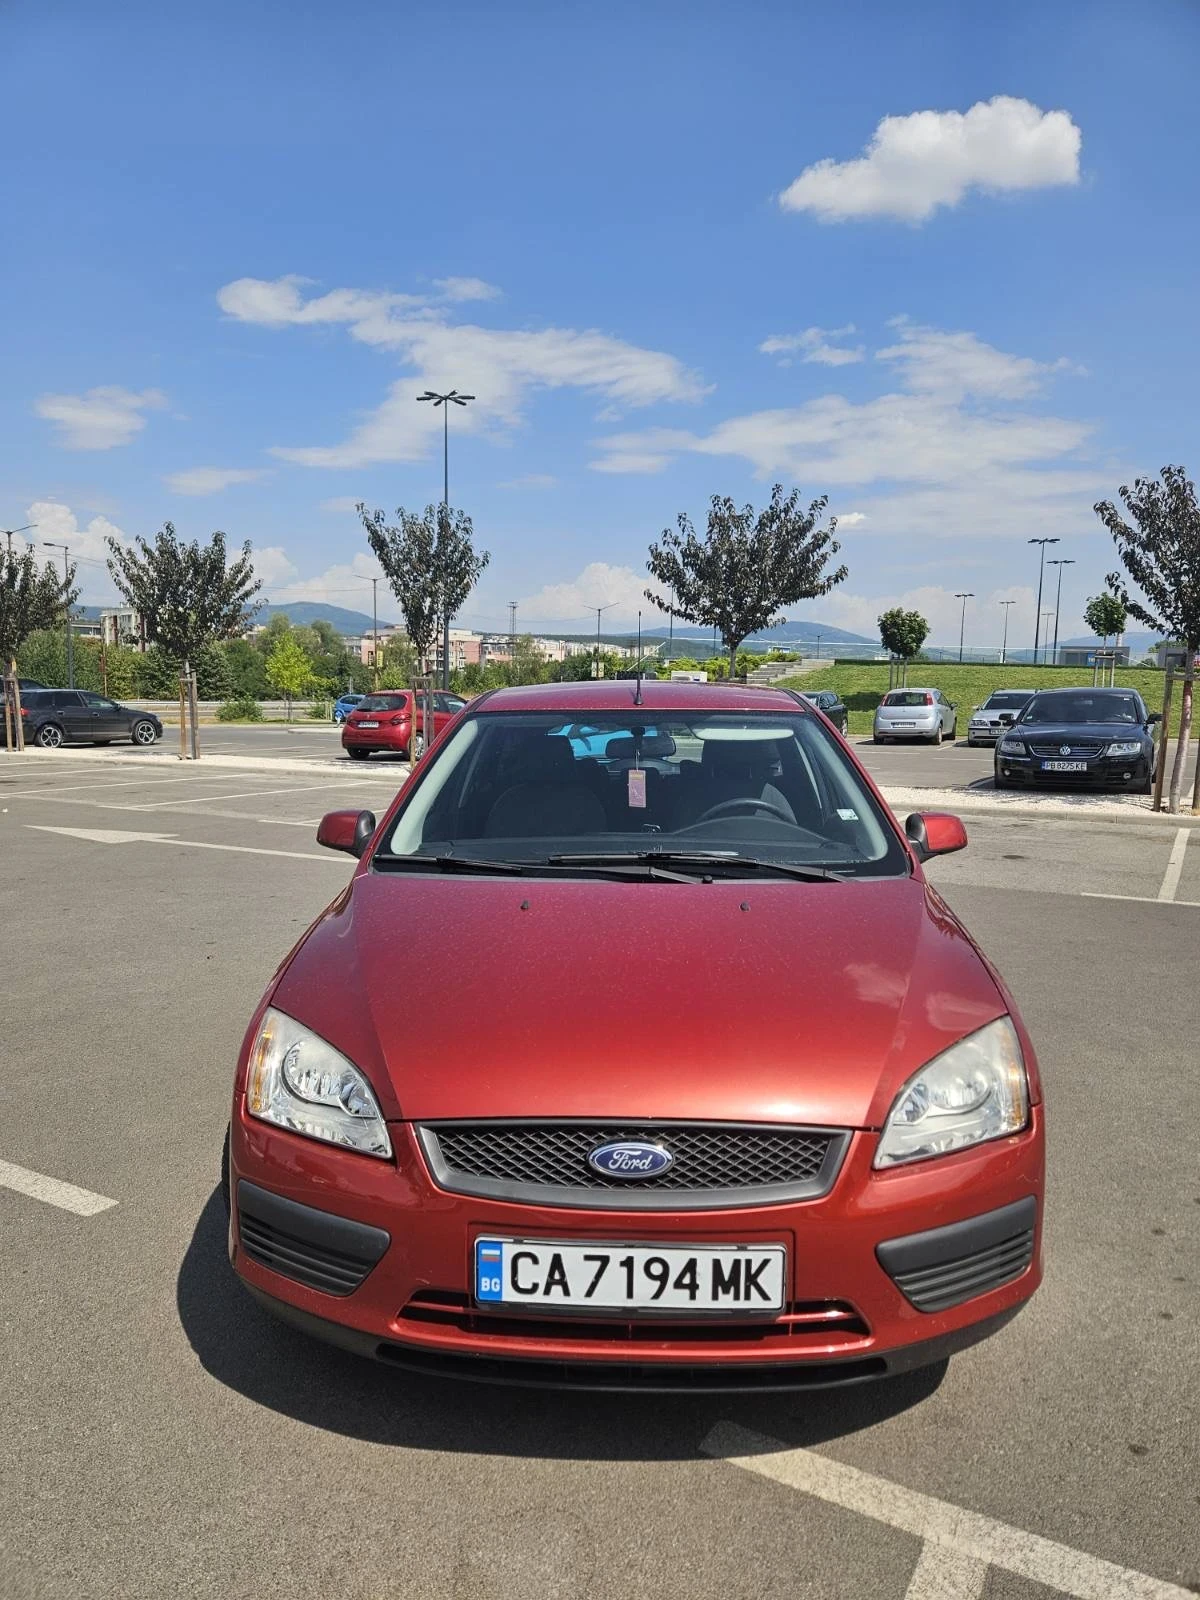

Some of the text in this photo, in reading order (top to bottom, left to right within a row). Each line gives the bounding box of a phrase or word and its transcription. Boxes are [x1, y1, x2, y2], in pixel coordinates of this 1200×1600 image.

[608, 1150, 653, 1170] Ford
[481, 1277, 501, 1292] BG
[510, 1251, 772, 1301] CA 7194 MK
